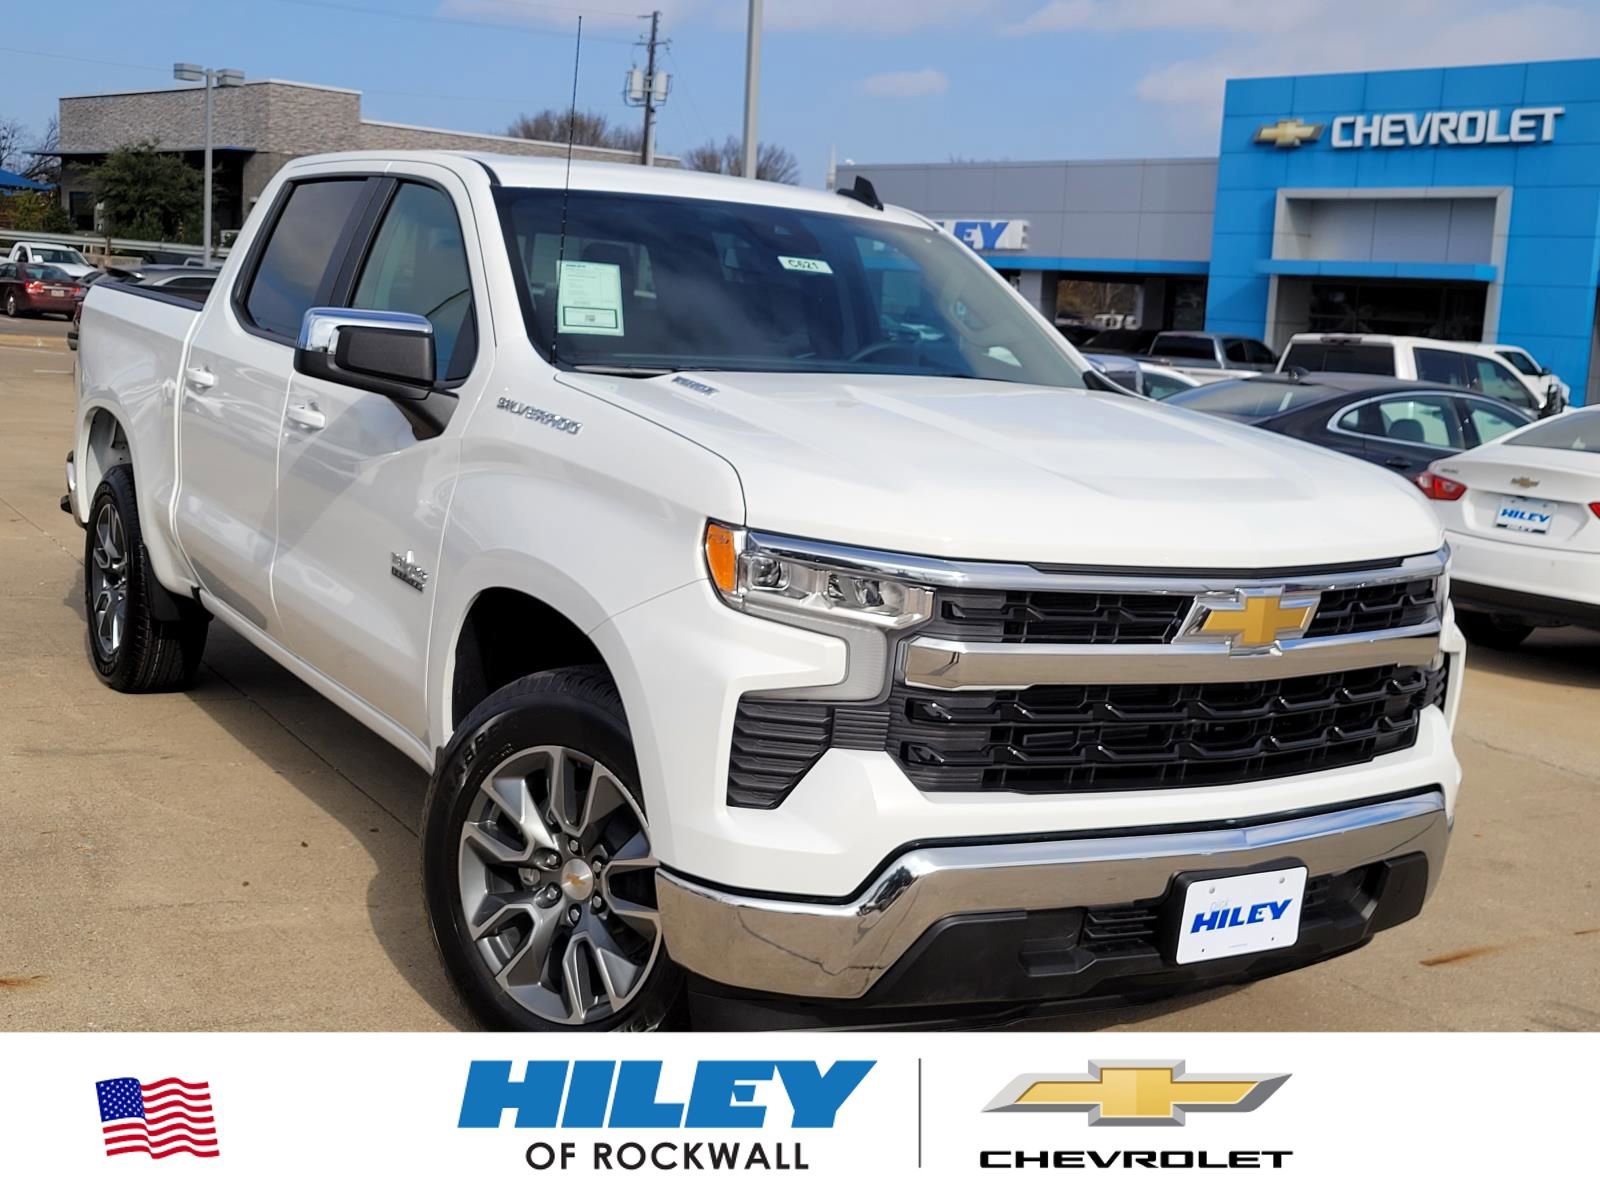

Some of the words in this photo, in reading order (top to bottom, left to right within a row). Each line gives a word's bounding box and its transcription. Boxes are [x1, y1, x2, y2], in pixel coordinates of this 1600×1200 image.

[1331, 107, 1565, 148] CHEVROLET
[1501, 507, 1550, 524] HILEY
[1190, 898, 1294, 934] HILEY
